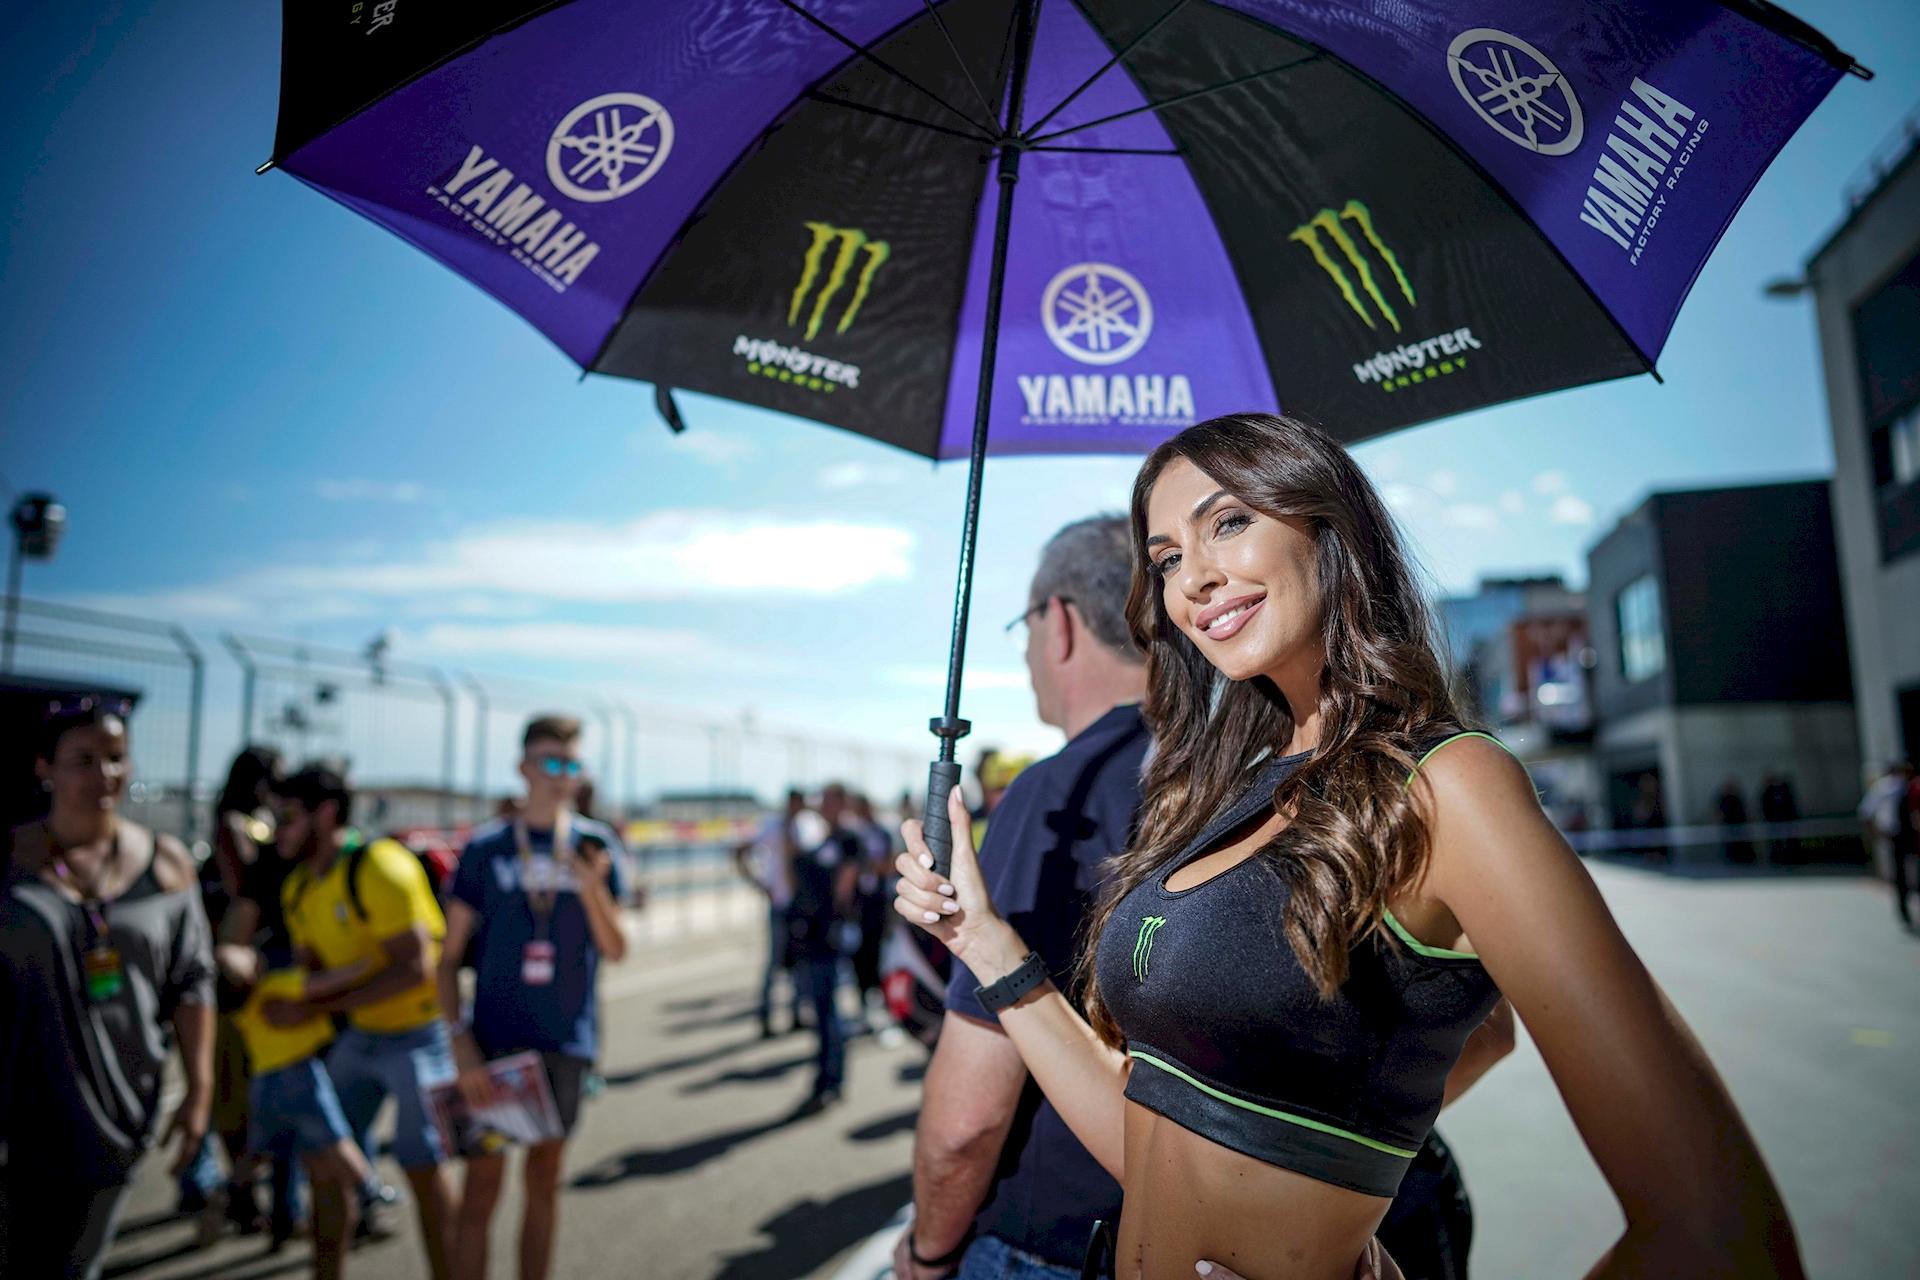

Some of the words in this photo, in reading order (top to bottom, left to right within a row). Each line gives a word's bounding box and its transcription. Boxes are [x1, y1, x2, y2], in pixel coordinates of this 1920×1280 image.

[1579, 76, 1696, 250] YAMAHA
[1629, 194, 1667, 266] FACTORY
[1665, 118, 1710, 190] RACING
[426, 185, 509, 246] FACTORY
[443, 144, 601, 286] YAMAHA
[733, 335, 860, 389] MONSTER
[1352, 327, 1482, 383] MONSTER
[1017, 374, 1195, 417] YAMAHA
